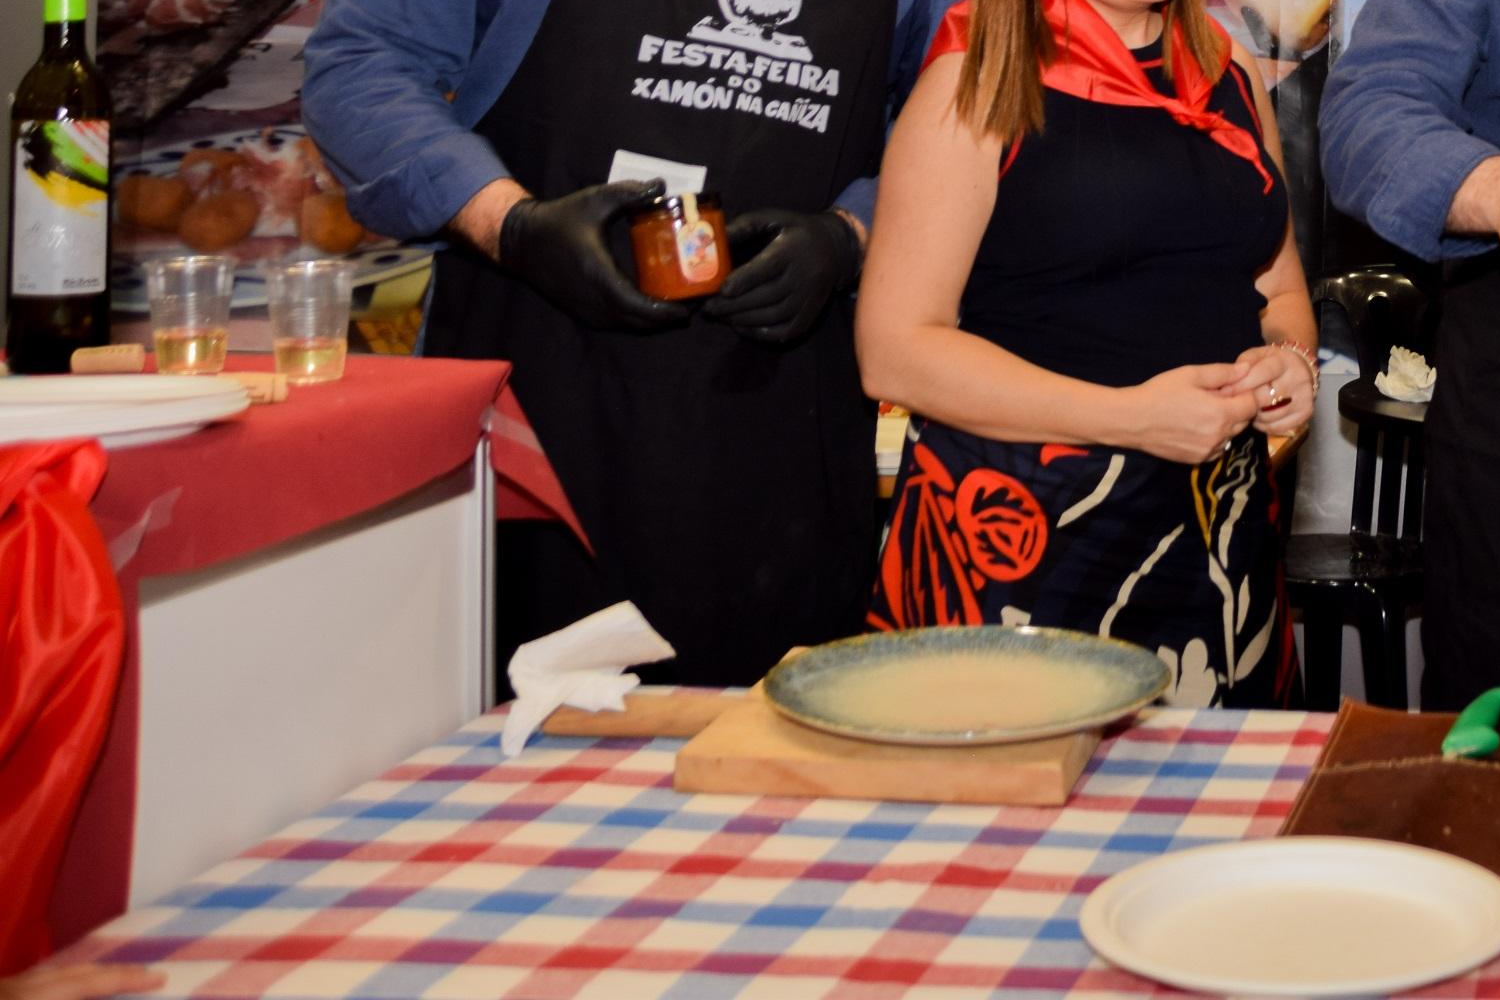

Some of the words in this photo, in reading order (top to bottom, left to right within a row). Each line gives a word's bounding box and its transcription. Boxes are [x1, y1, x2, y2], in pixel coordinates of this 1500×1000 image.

[637, 34, 841, 96] FESTA-FEIRA
[631, 77, 734, 110] XAMÓN
[735, 92, 763, 115] NA
[728, 75, 762, 94] DO
